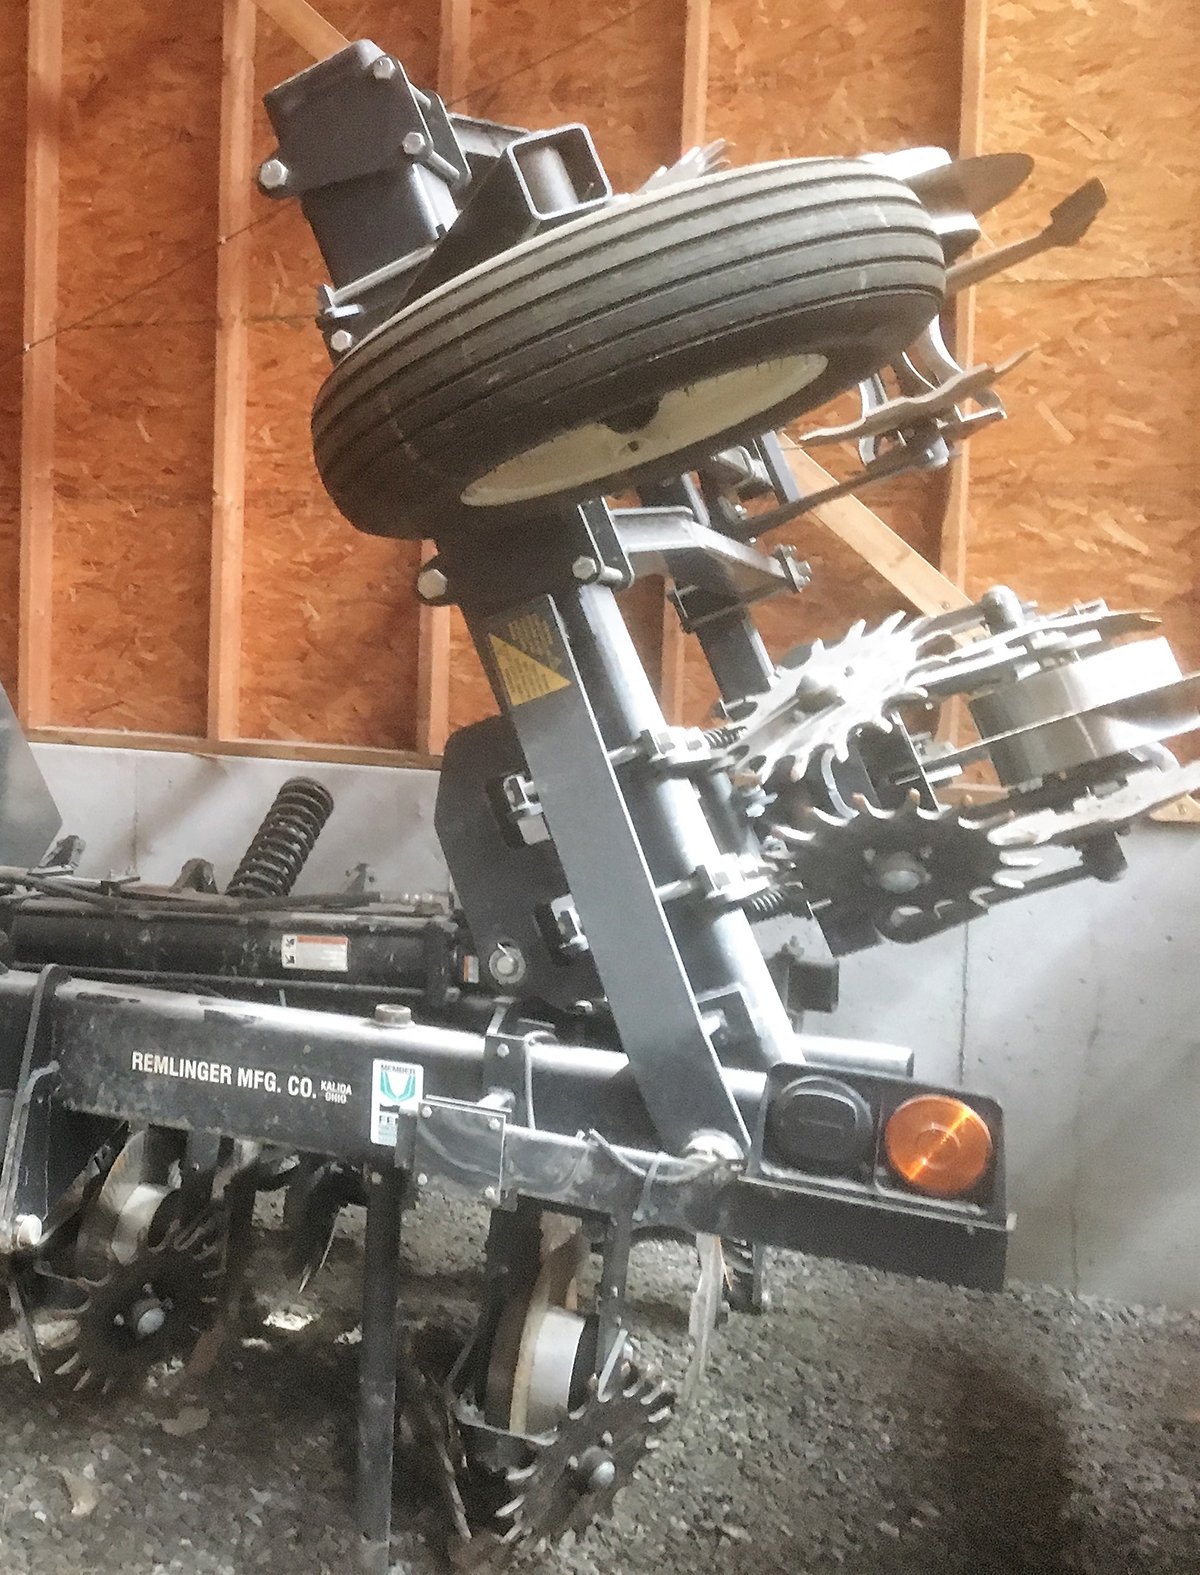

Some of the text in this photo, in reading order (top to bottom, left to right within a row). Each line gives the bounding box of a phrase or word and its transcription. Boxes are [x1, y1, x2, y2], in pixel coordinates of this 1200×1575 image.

[132, 1051, 317, 1099] REMLINGER MFG. CO.
[320, 1080, 352, 1095] KALIDA
[325, 1091, 347, 1104] OHIO
